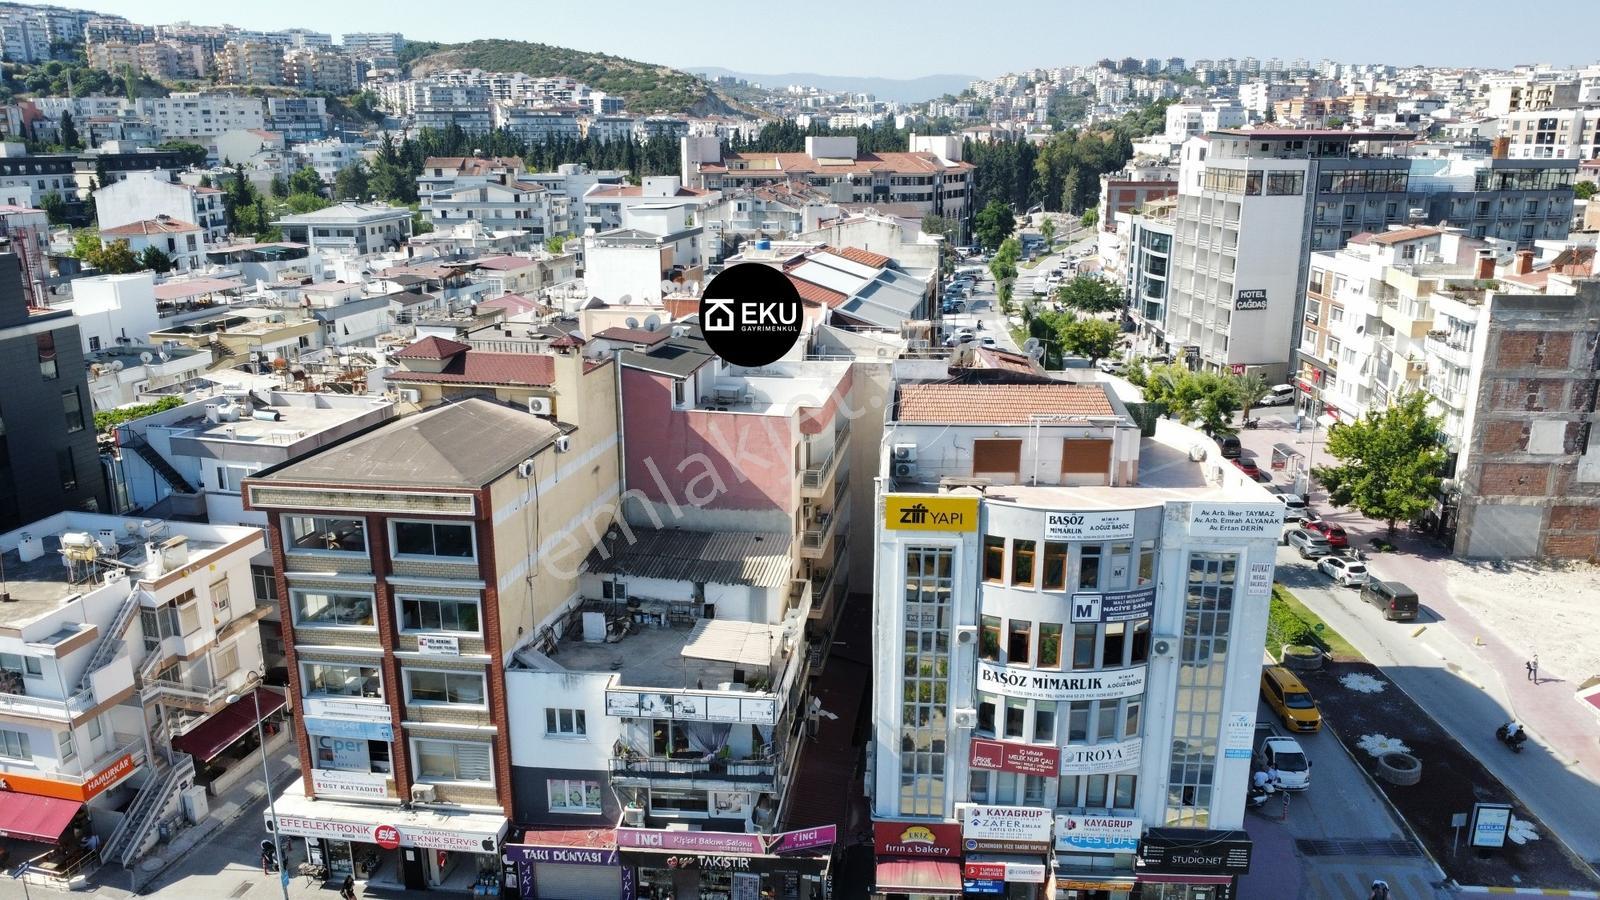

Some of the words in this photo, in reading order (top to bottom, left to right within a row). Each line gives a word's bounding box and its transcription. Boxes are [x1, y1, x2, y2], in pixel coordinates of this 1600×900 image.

[1240, 291, 1265, 299] HOTEL
[1236, 299, 1267, 310] ÇAĞDAŞ
[930, 511, 963, 525] YAPI
[1049, 513, 1084, 527] BAŞÖZ
[982, 669, 1028, 688] BAŞÖZ
[1032, 674, 1102, 690] MİMARLIK
[1076, 749, 1122, 762] TROYA
[340, 784, 380, 793] KATTADIR
[986, 808, 1043, 818] KAYAGRUP
[280, 818, 301, 828] EFE
[982, 819, 1020, 828] ZAFER
[1084, 818, 1133, 829] KAYAGRUP
[635, 831, 663, 846] İNCİ
[522, 849, 549, 860] TAKI
[553, 848, 602, 863] DÜNYASI
[915, 845, 951, 855] bakery
[1171, 855, 1205, 865] STUDIO
[1206, 856, 1222, 865] NET
